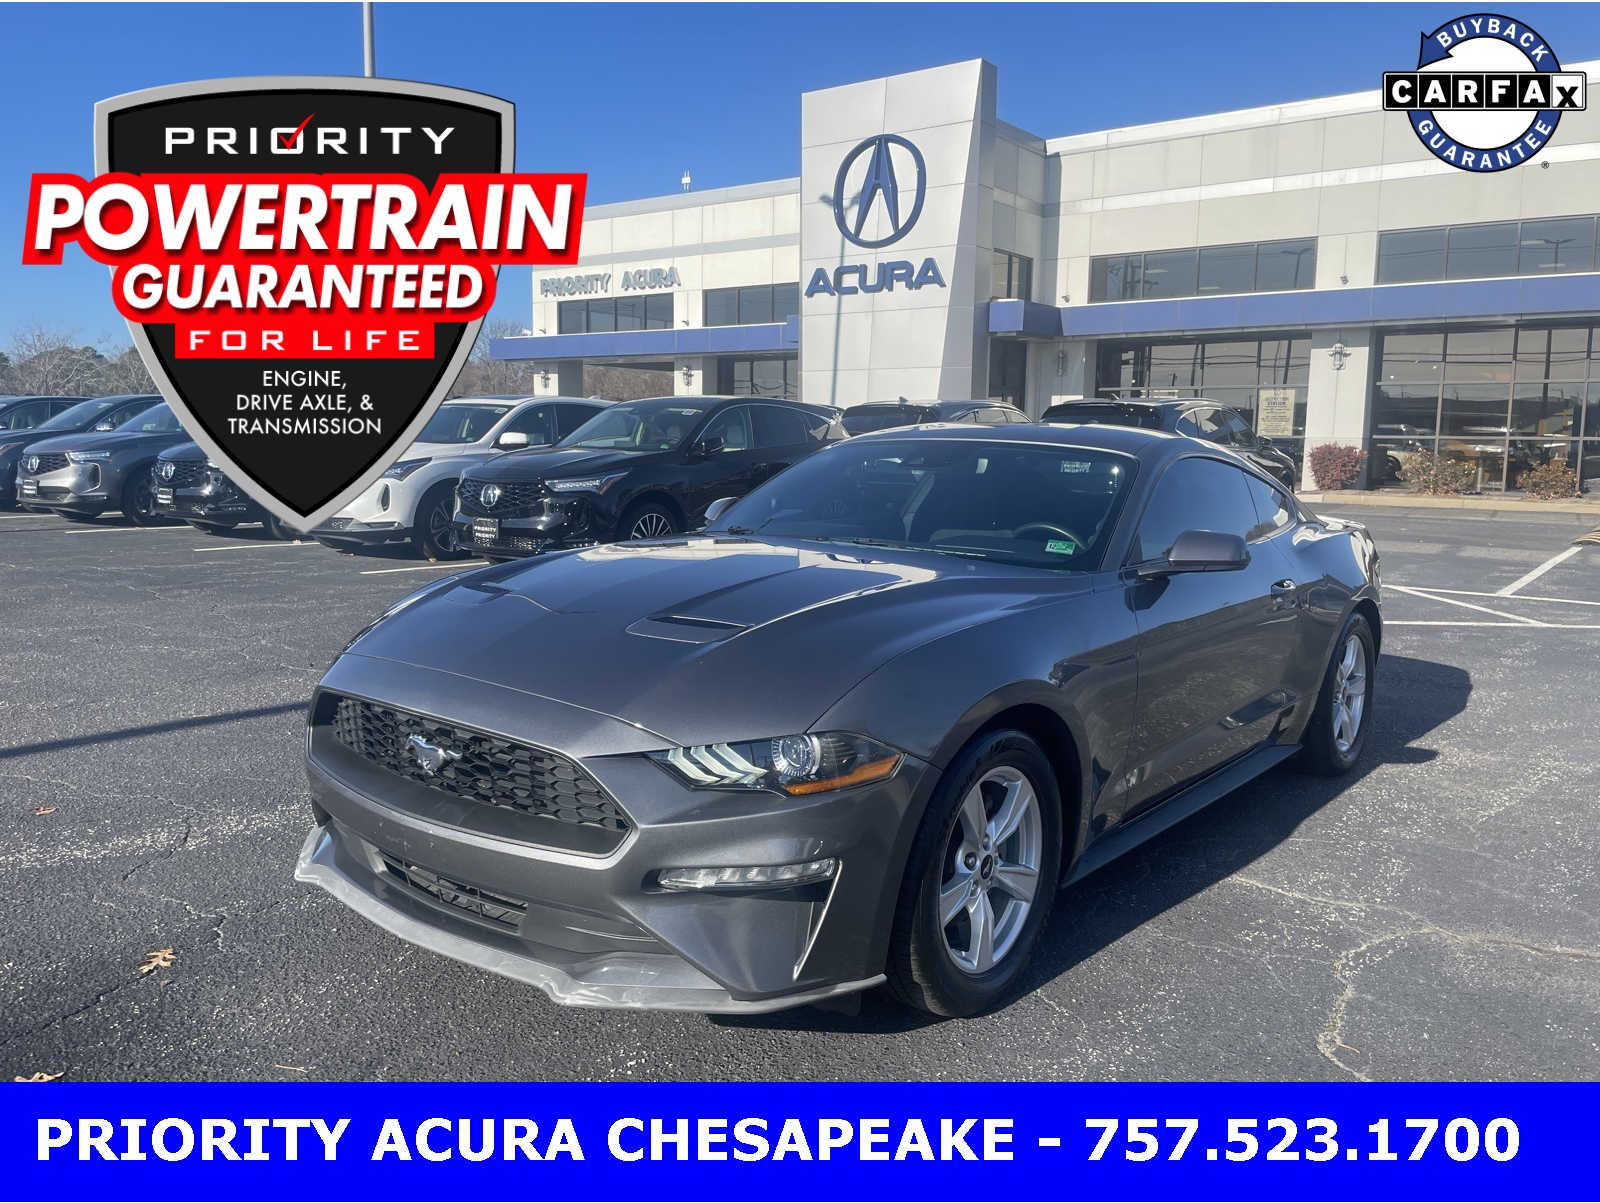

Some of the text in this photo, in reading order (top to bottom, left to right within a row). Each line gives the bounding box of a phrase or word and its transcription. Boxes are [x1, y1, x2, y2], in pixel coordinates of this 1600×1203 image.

[540, 266, 681, 298] PRIORITY ACURA
[804, 257, 946, 298] ACURA
